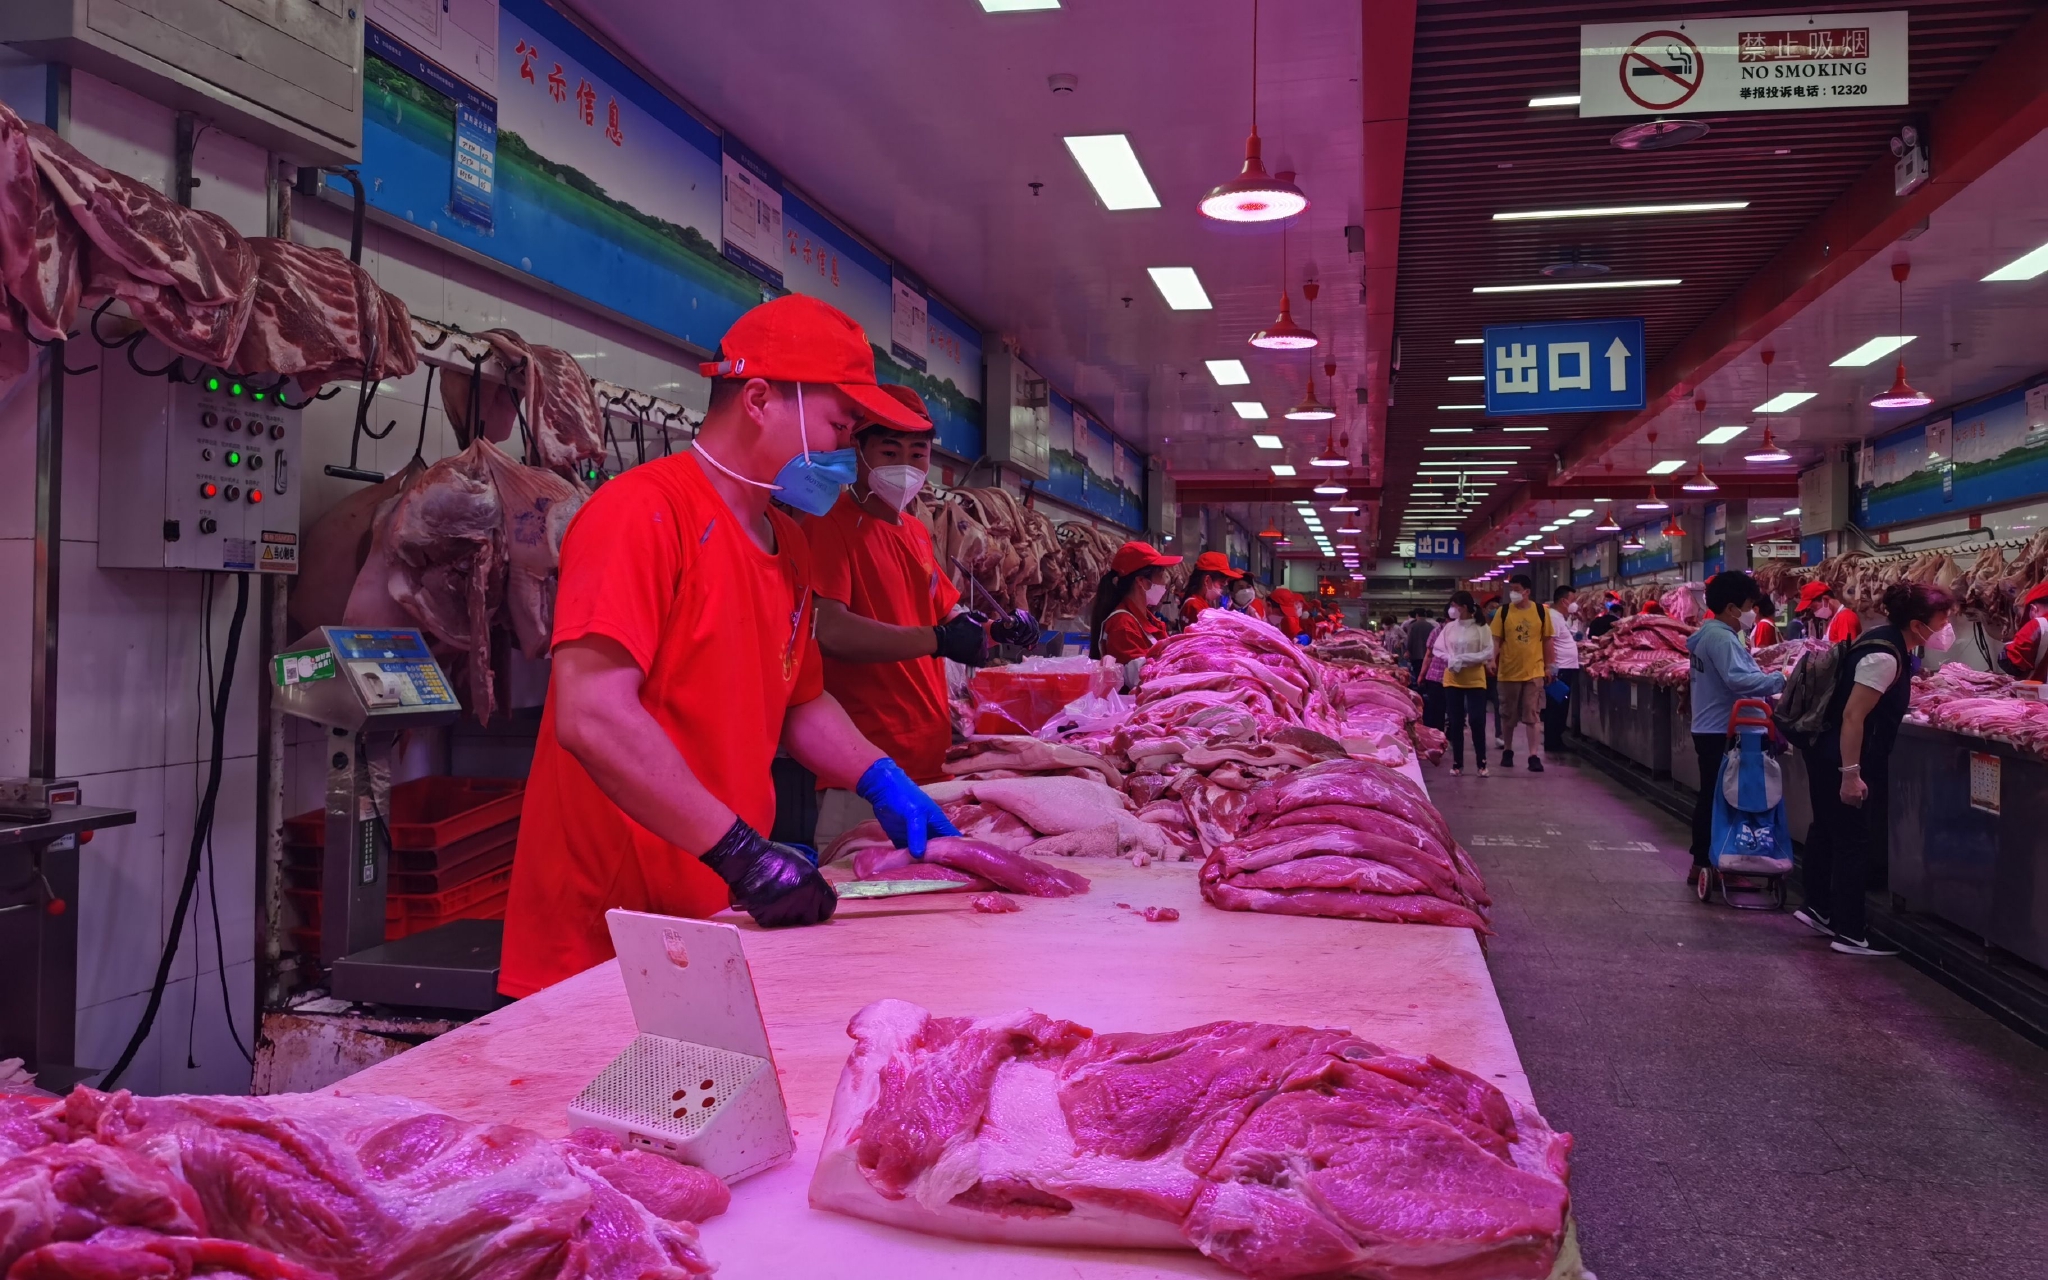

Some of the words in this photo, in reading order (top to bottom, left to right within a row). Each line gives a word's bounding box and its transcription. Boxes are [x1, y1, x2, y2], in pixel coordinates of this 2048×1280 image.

[1741, 29, 1868, 62] 禁止吸烟
[1741, 66, 1769, 79] NO
[1775, 62, 1867, 78] SMOKING
[515, 38, 625, 147] 公示信息
[786, 228, 840, 287] 公示信息
[1495, 341, 1591, 394] 出口
[1418, 535, 1449, 554] 出口
